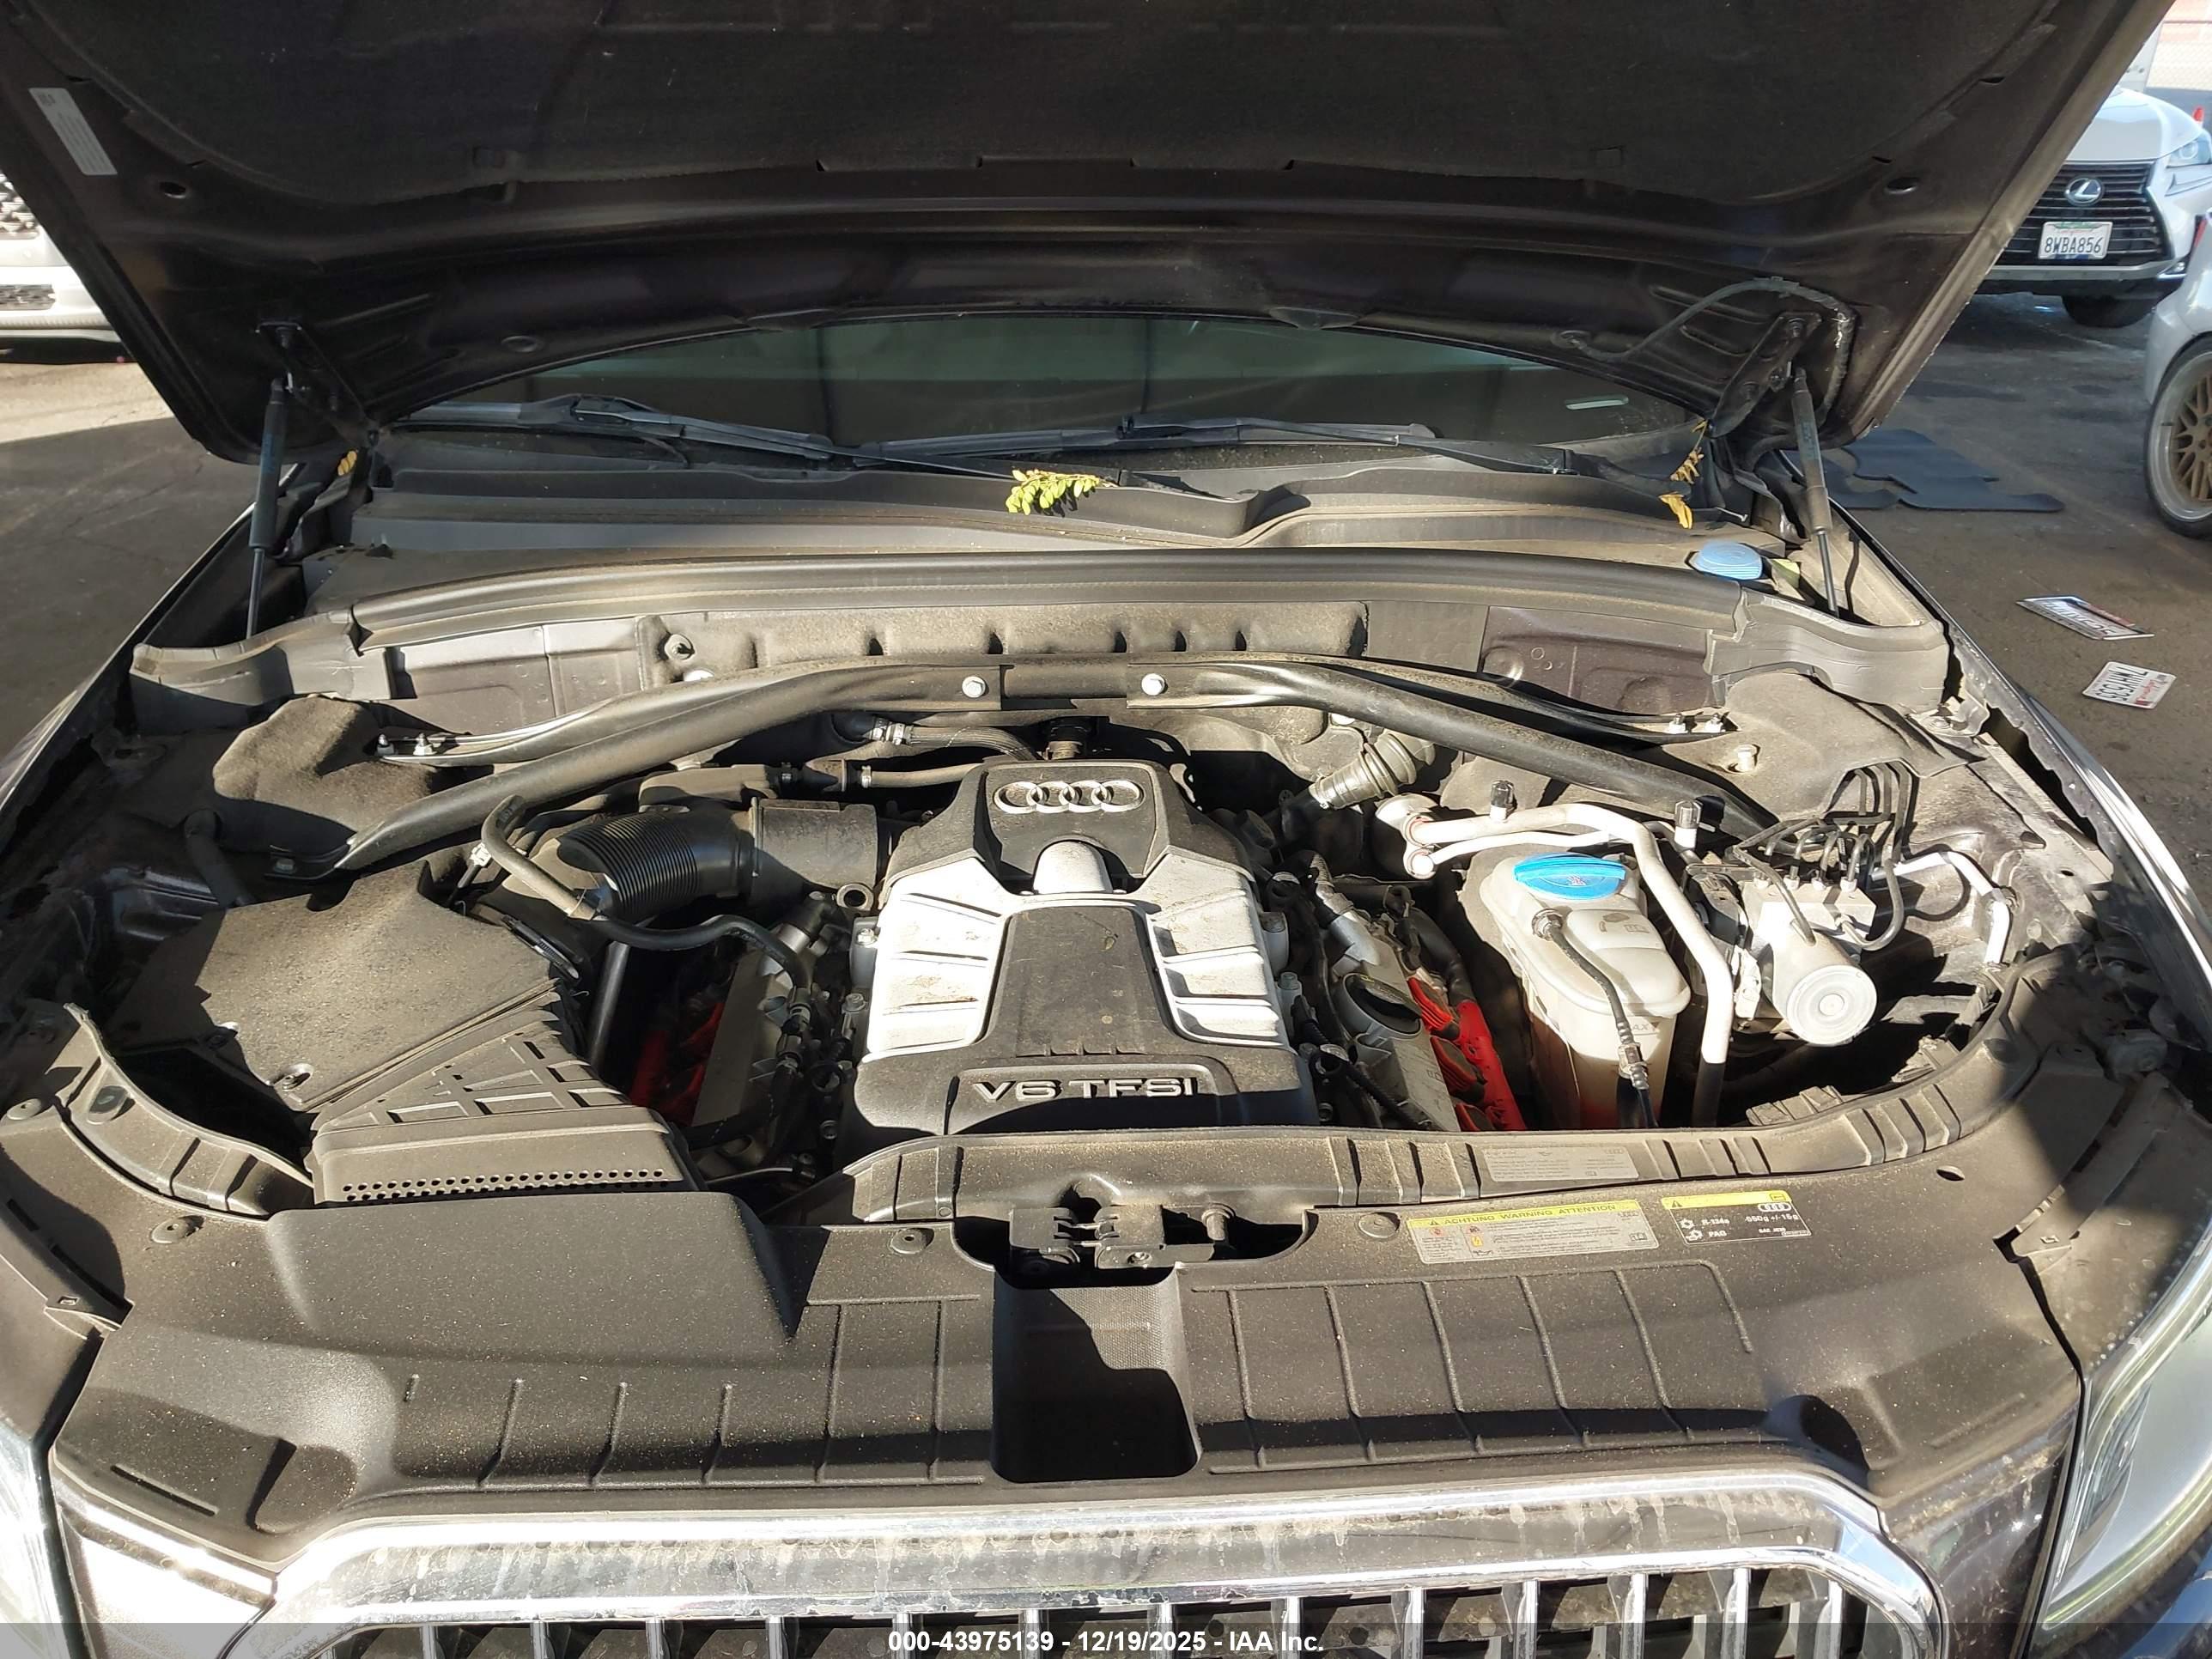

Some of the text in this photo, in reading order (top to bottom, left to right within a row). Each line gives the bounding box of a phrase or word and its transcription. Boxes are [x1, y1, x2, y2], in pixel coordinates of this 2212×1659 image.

[2044, 236, 2104, 253] 8WBA856
[973, 1077, 1194, 1102] V6 TFSI
[1444, 1204, 1616, 1225] ACHTUNG WARNING ATTENTION
